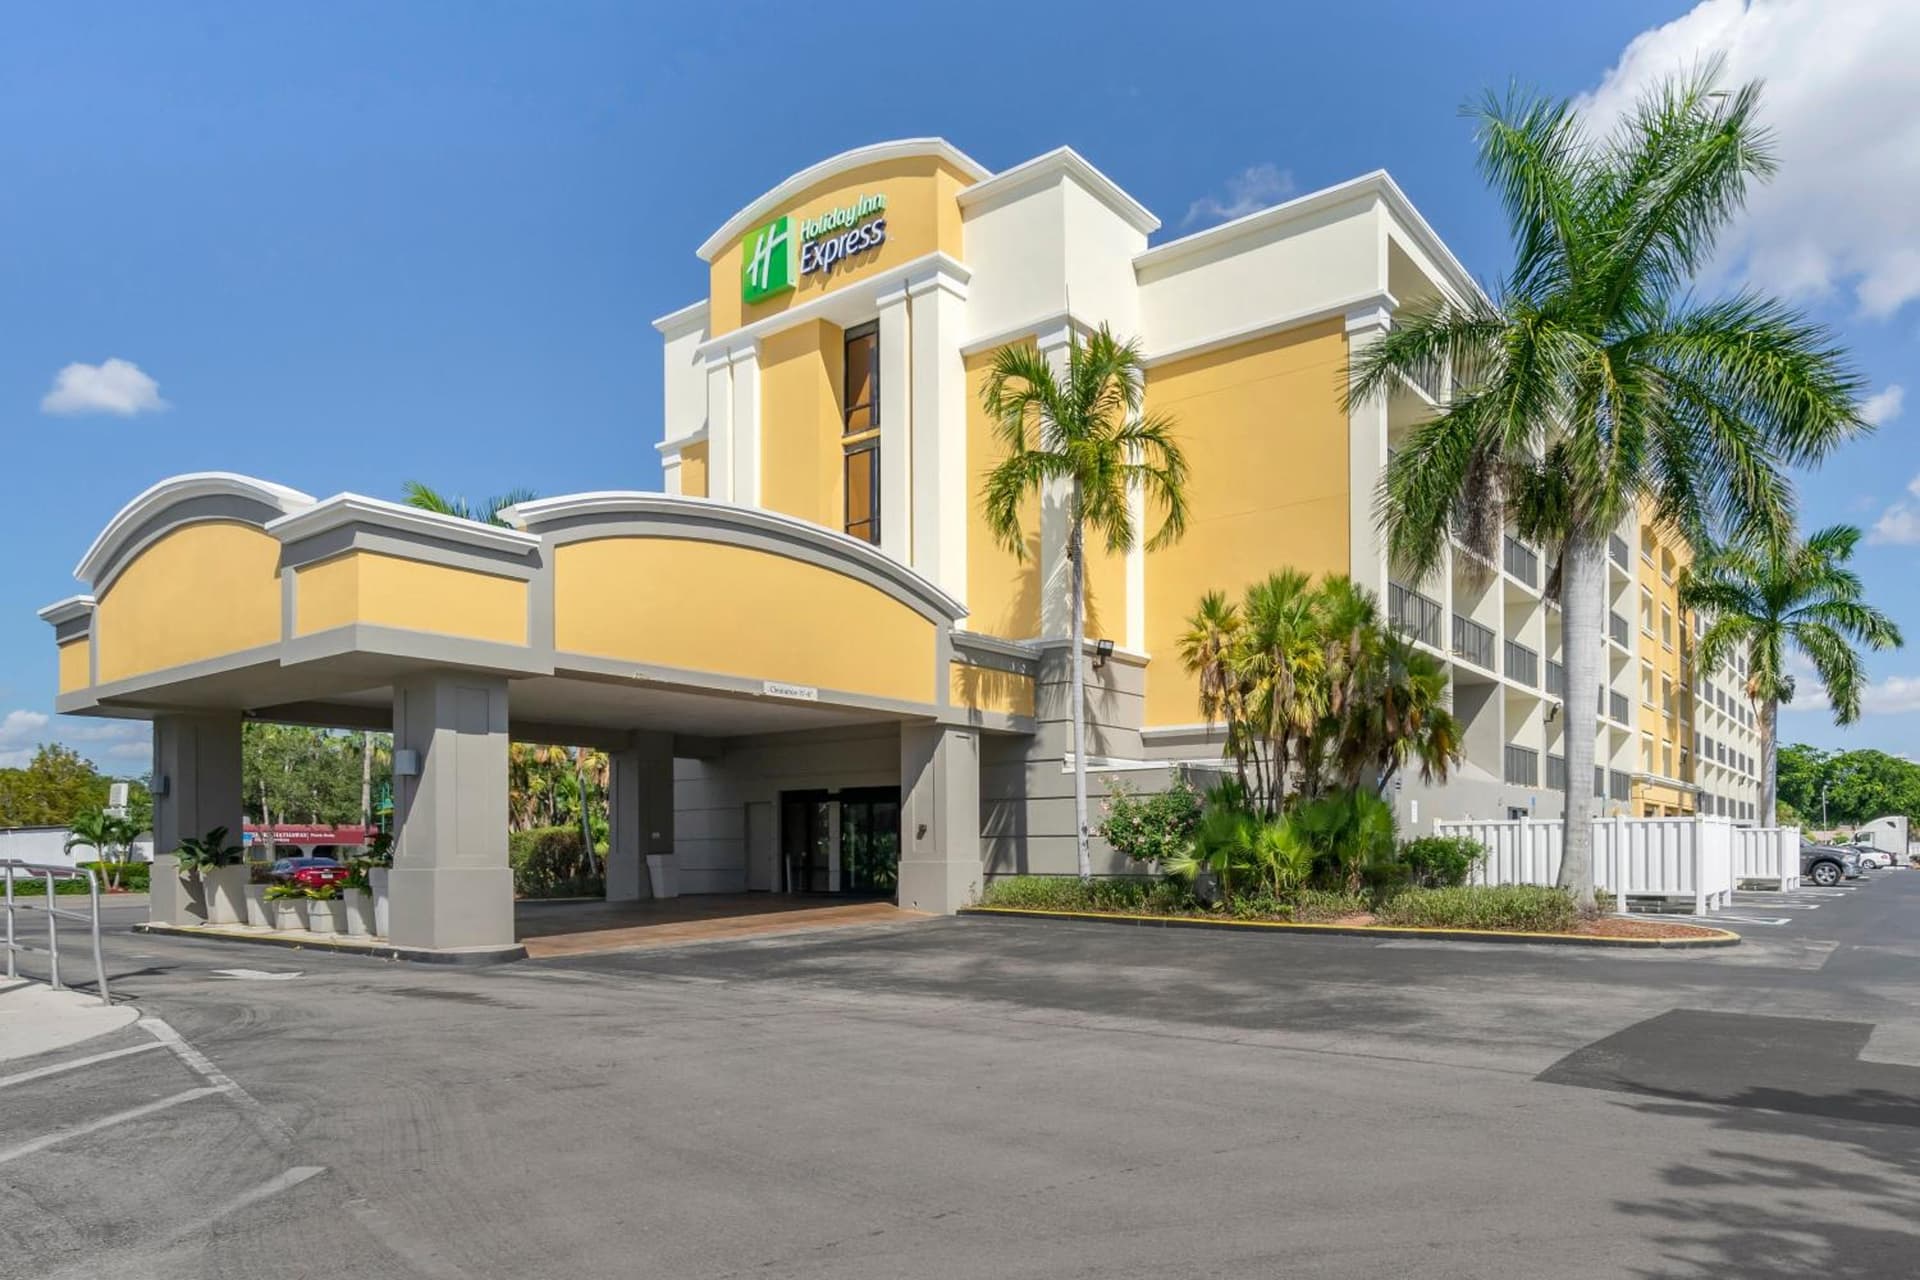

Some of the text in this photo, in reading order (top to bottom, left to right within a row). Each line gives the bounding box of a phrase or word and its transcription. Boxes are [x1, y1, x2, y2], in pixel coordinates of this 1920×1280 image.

[801, 193, 886, 241] Holiday Inn
[801, 219, 885, 273] Express
